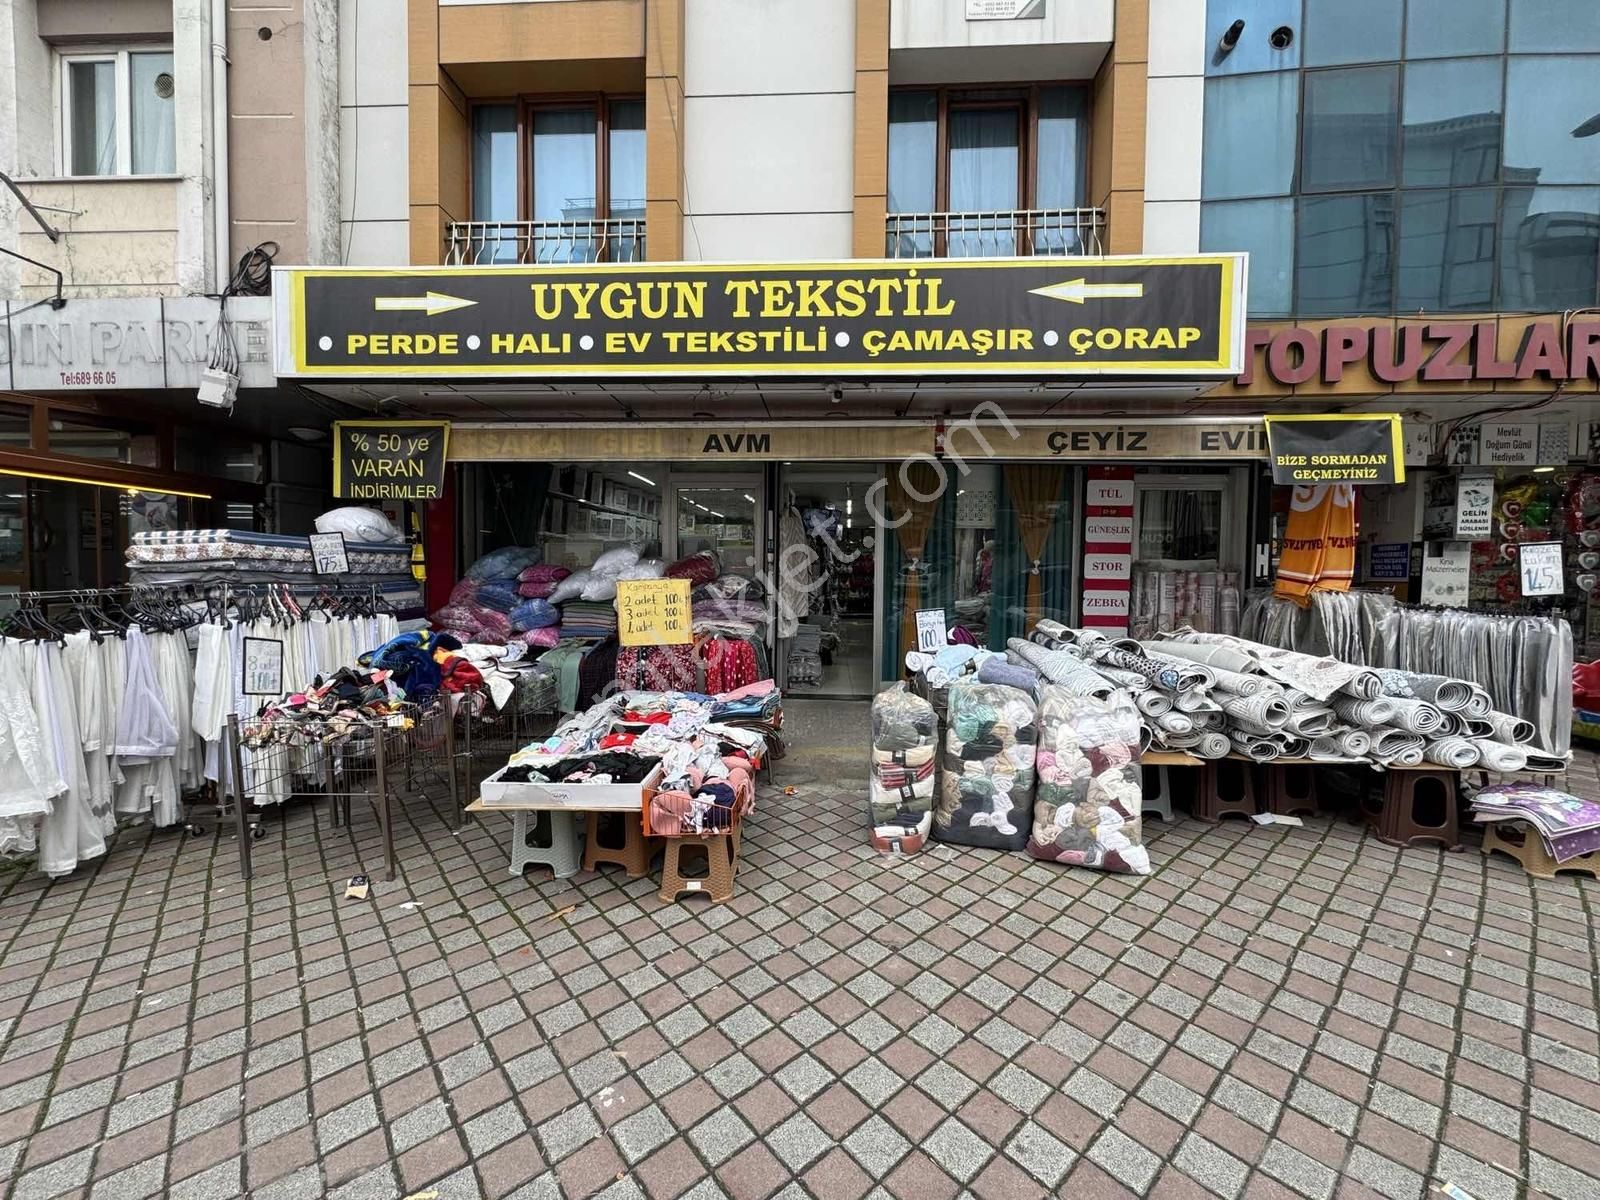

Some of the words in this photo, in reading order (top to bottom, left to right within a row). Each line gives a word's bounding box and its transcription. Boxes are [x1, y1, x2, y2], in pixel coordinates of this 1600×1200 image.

[530, 280, 708, 321] UYGUN
[724, 268, 956, 319] TEKSTİL
[346, 332, 460, 355] PERDE
[491, 332, 572, 354] HALI
[604, 331, 652, 353] EV
[662, 324, 828, 353] TEKSTİLİ
[862, 328, 1034, 357] ÇAMAŞIR
[1068, 326, 1202, 355] ÇORAP
[93, 371, 103, 384] 66
[106, 371, 117, 384] 05
[377, 434, 401, 452] 50
[407, 437, 430, 456] ye
[702, 433, 771, 454] AVM
[1046, 425, 1148, 455] ÇEYİZ
[1277, 454, 1307, 466] BİZE
[1311, 454, 1387, 466] SORMADAN
[351, 459, 425, 477] VARAN
[1293, 467, 1378, 482] GEÇMEYİNİZ
[350, 482, 437, 498] İNDİRİMLER
[1099, 488, 1123, 499] TÜL
[1092, 561, 1123, 571] STOR
[635, 594, 656, 605] adet
[1086, 598, 1126, 608] ZEBRA
